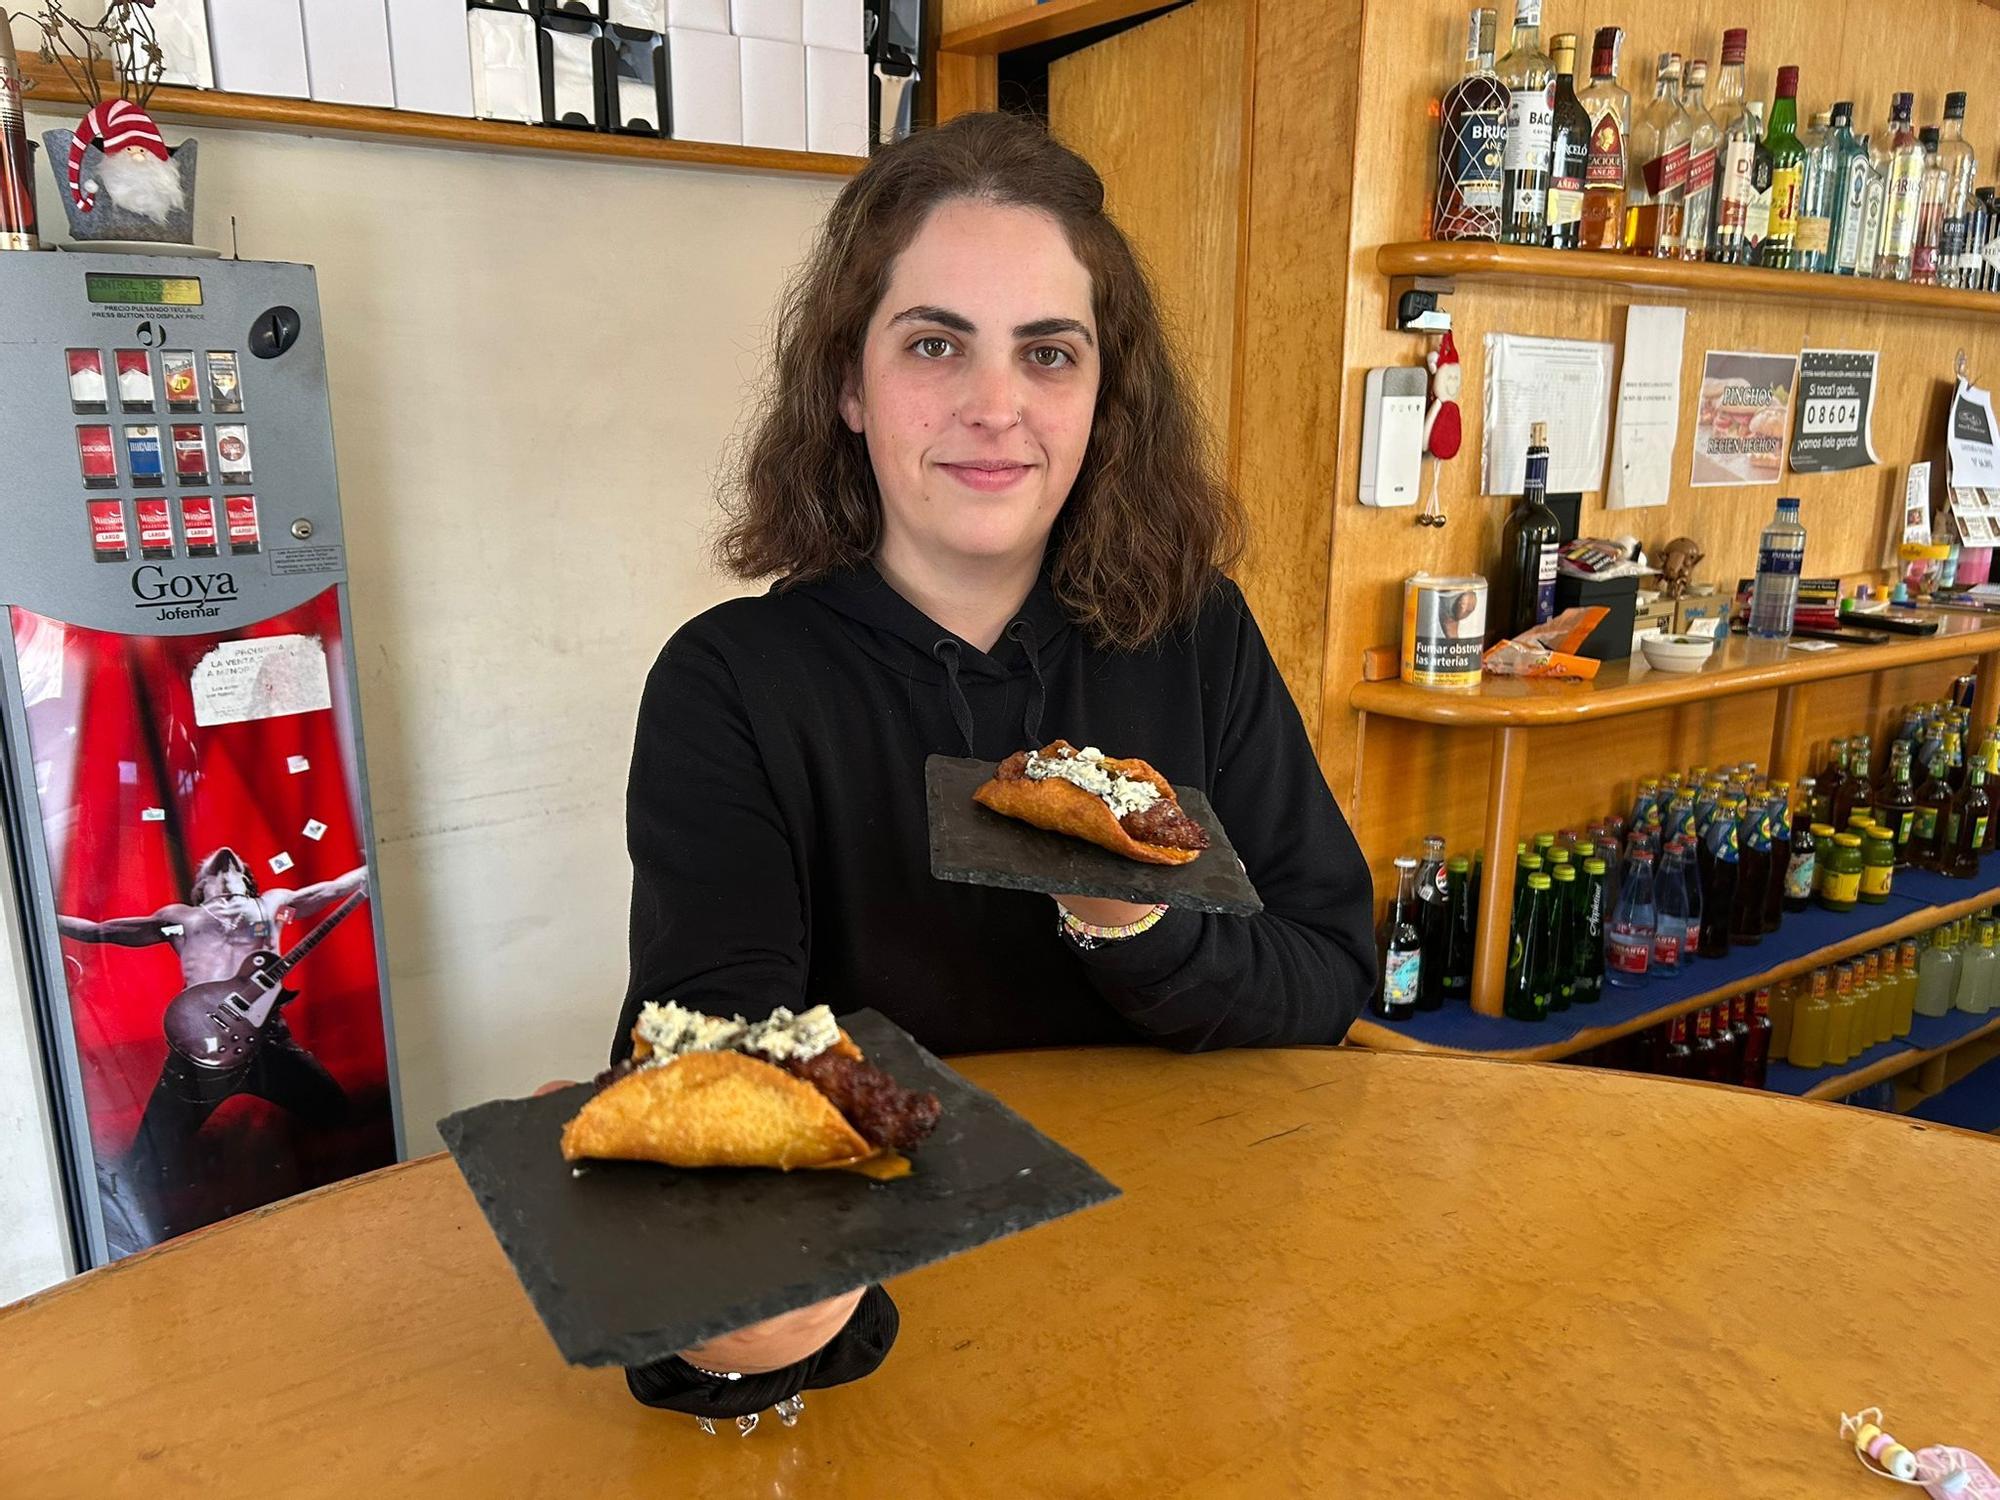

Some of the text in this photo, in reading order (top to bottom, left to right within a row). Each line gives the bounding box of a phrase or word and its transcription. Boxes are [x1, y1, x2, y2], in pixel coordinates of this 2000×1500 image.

[132, 305, 168, 313] PULSANDO
[1722, 385, 1773, 407] PINCHOS
[1740, 436, 1777, 454] HECHOS
[93, 515, 121, 525] Winston
[140, 513, 168, 523] Winston
[131, 565, 239, 608] Goya
[156, 607, 221, 621] Jofemar
[1416, 641, 1447, 655] Fumar
[1415, 653, 1429, 666] las
